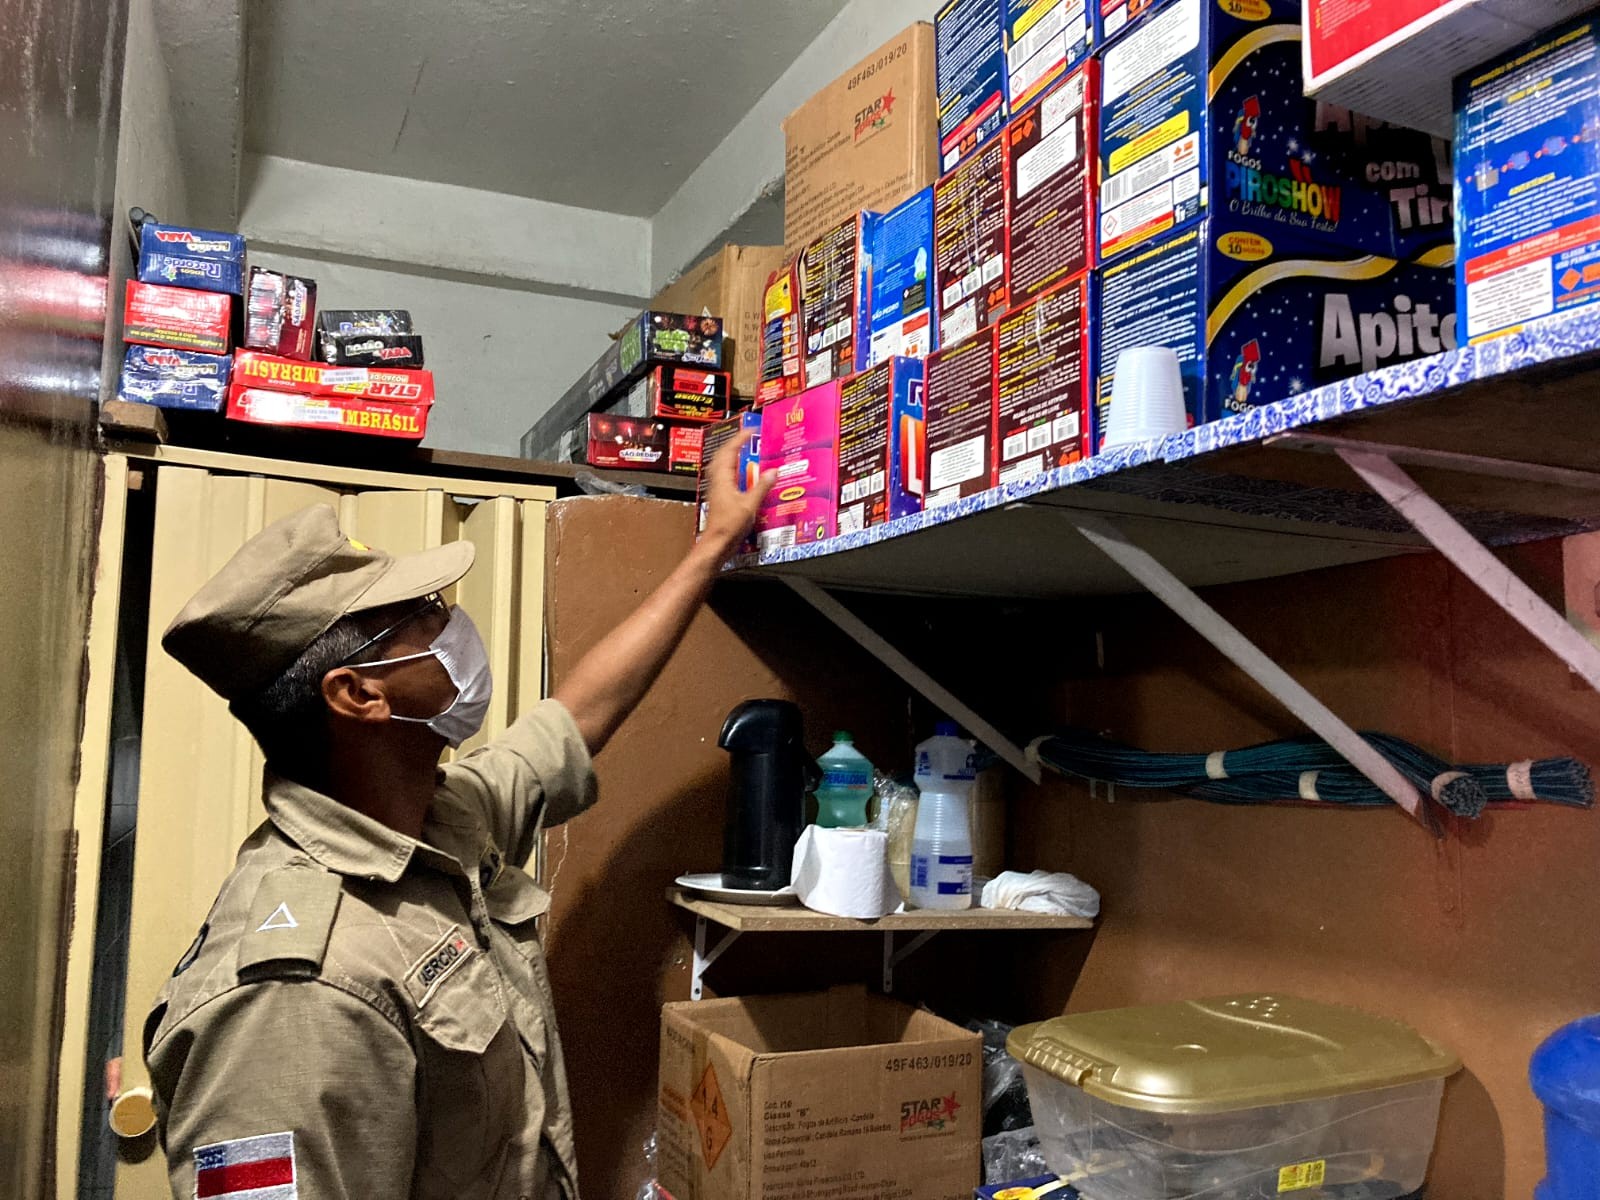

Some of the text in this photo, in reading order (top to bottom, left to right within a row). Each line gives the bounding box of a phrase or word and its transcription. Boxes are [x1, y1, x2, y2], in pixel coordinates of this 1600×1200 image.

[847, 42, 907, 90] 49F463/019/20
[855, 97, 882, 127] STAR
[1228, 150, 1262, 171] FOGOS
[1365, 161, 1420, 183] com
[1225, 160, 1340, 223] PIROSHOW
[1389, 184, 1455, 229] Tir
[368, 382, 422, 399] STAR
[1225, 398, 1257, 412] FOGO
[885, 1053, 972, 1072] 49F463/019/20
[900, 1097, 942, 1120] STAR
